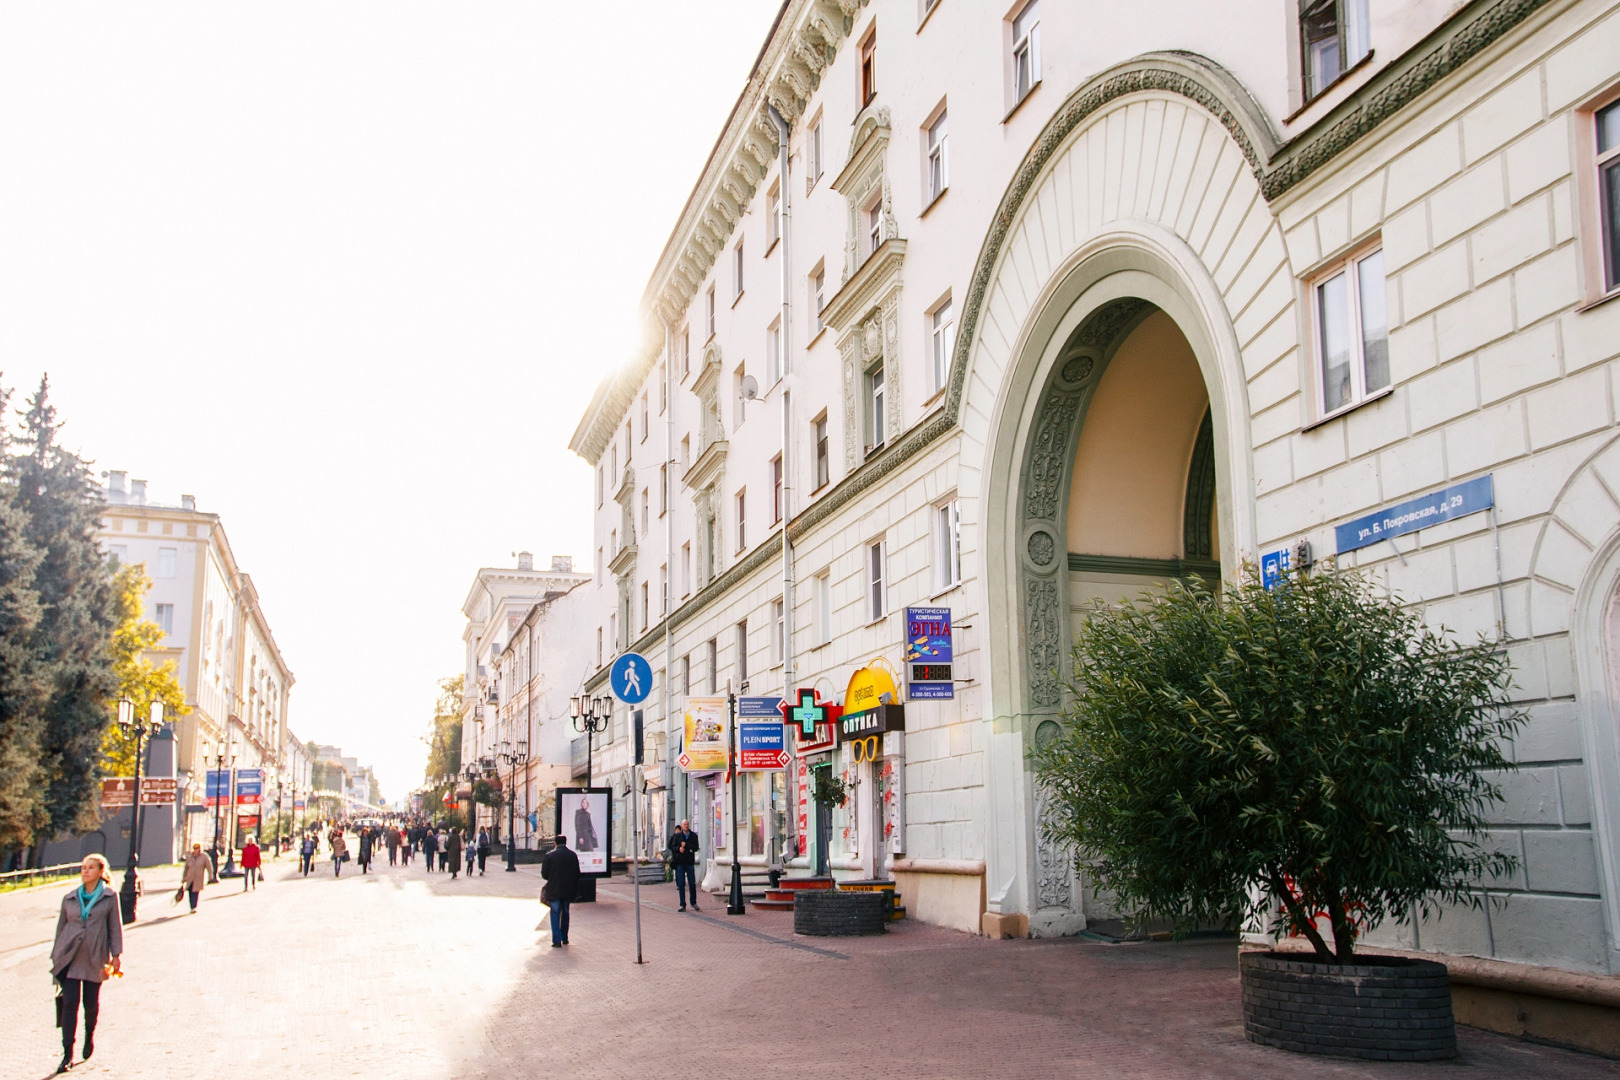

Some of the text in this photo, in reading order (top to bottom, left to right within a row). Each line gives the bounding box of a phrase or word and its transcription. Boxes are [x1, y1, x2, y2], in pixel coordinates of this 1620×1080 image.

[1358, 494, 1463, 541] ул. Б. Покровская, д. 29
[909, 621, 951, 636] ЭГНА
[843, 713, 878, 734] ОПТИКА
[743, 736, 781, 744] PLEIN SPORT
